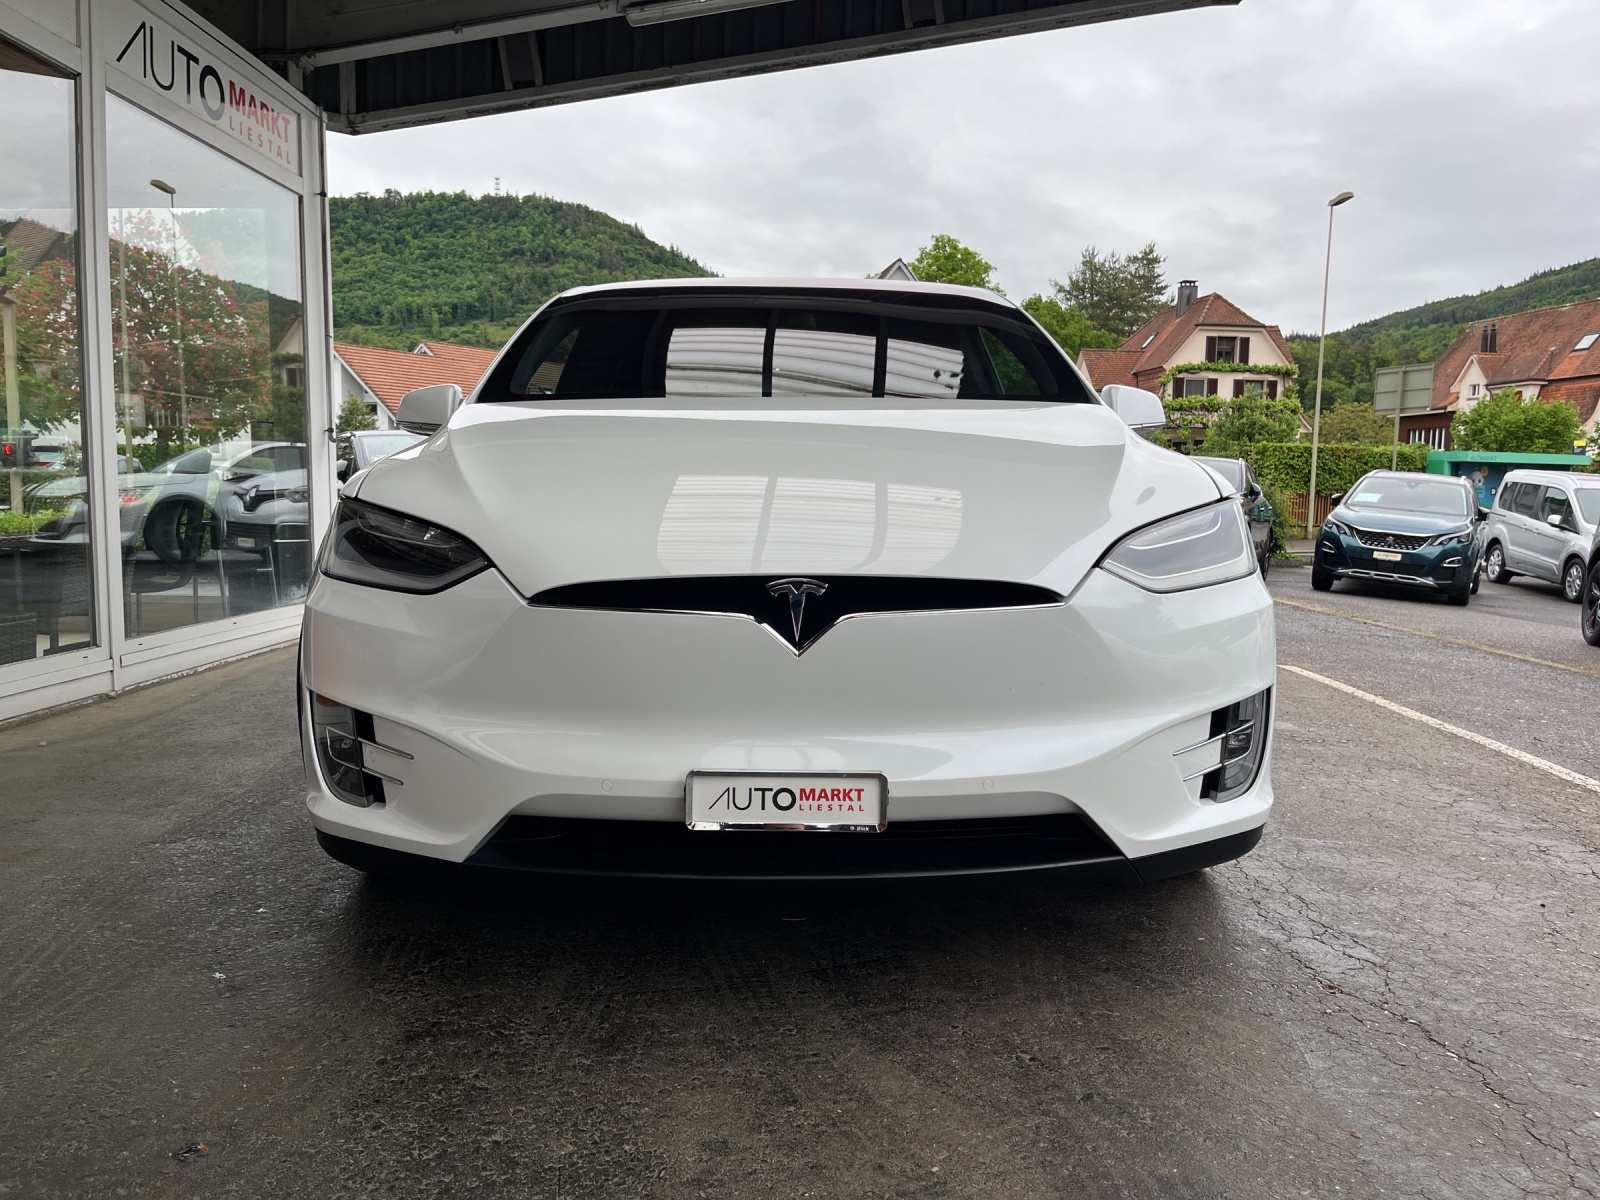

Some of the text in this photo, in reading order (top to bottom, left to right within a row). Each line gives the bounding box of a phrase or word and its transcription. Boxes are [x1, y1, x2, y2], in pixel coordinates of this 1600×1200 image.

[229, 79, 291, 143] MARKT
[229, 115, 291, 165] LIESTAL
[799, 788, 864, 802] MARKT
